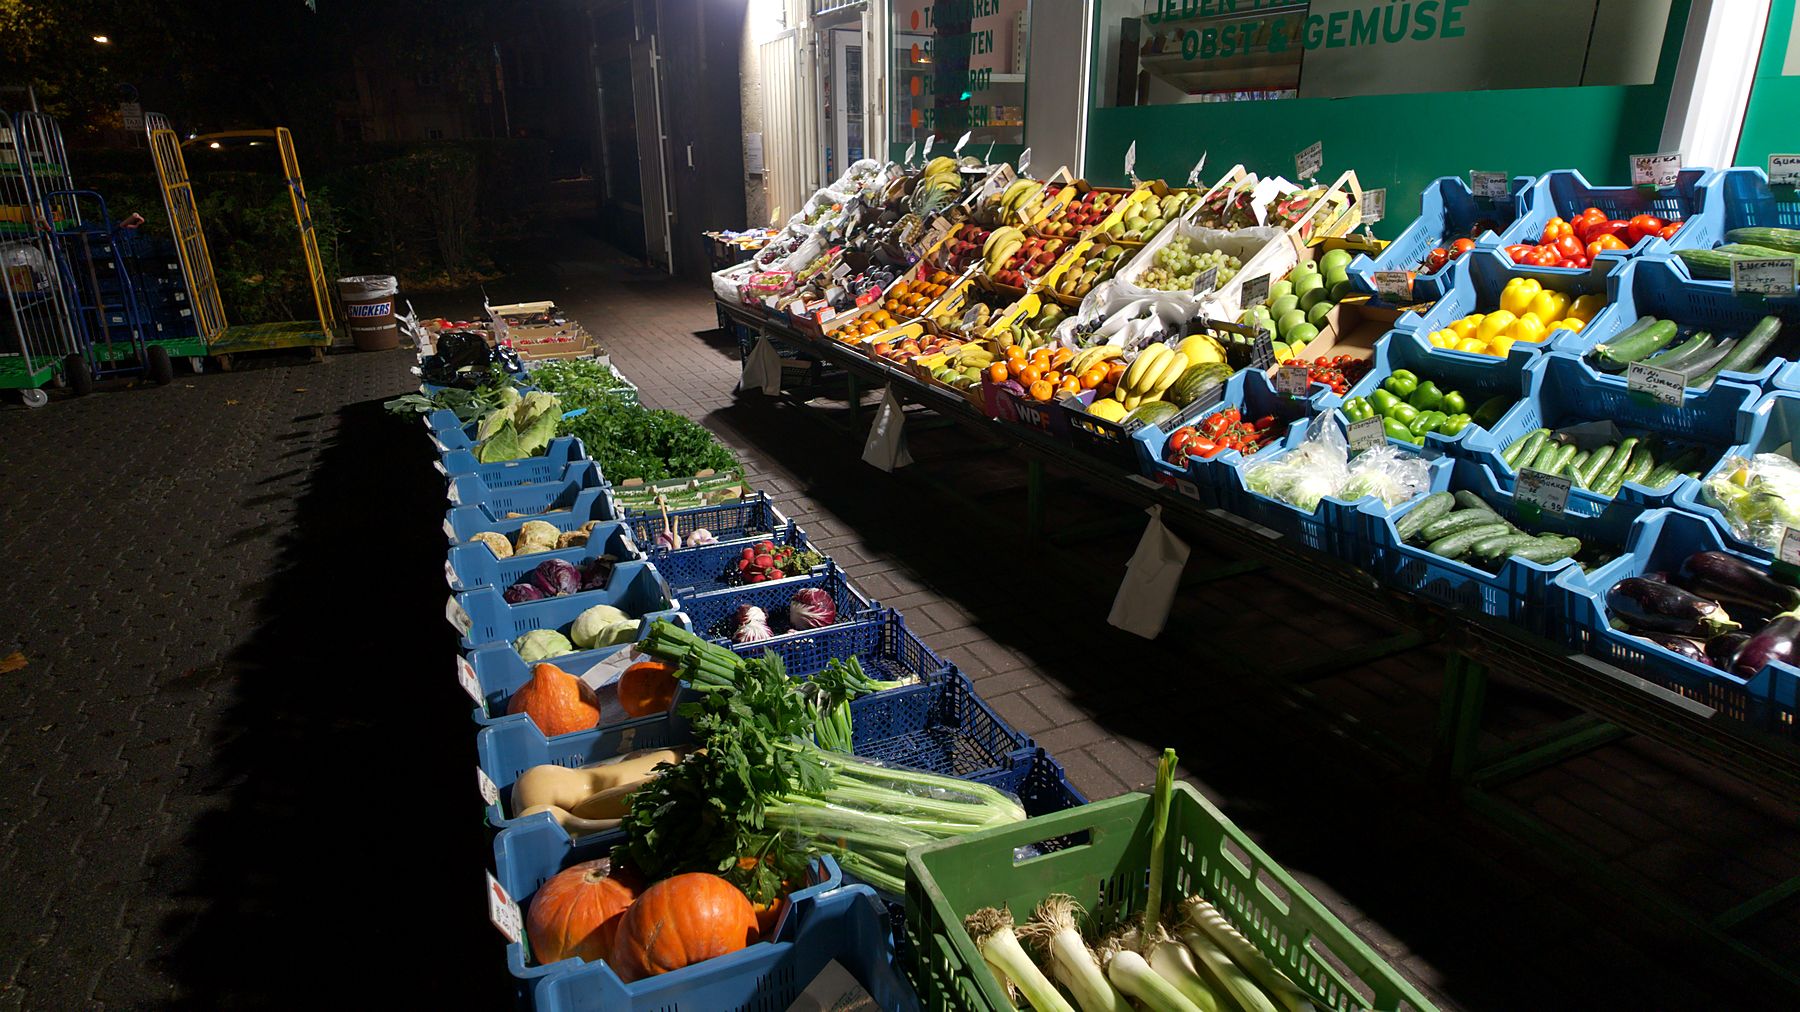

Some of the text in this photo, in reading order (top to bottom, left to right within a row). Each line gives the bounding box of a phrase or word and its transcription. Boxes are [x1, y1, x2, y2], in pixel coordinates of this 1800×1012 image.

[1181, 0, 1470, 61] OBST & GEMÜSE
[349, 304, 390, 317] SNICKERS
